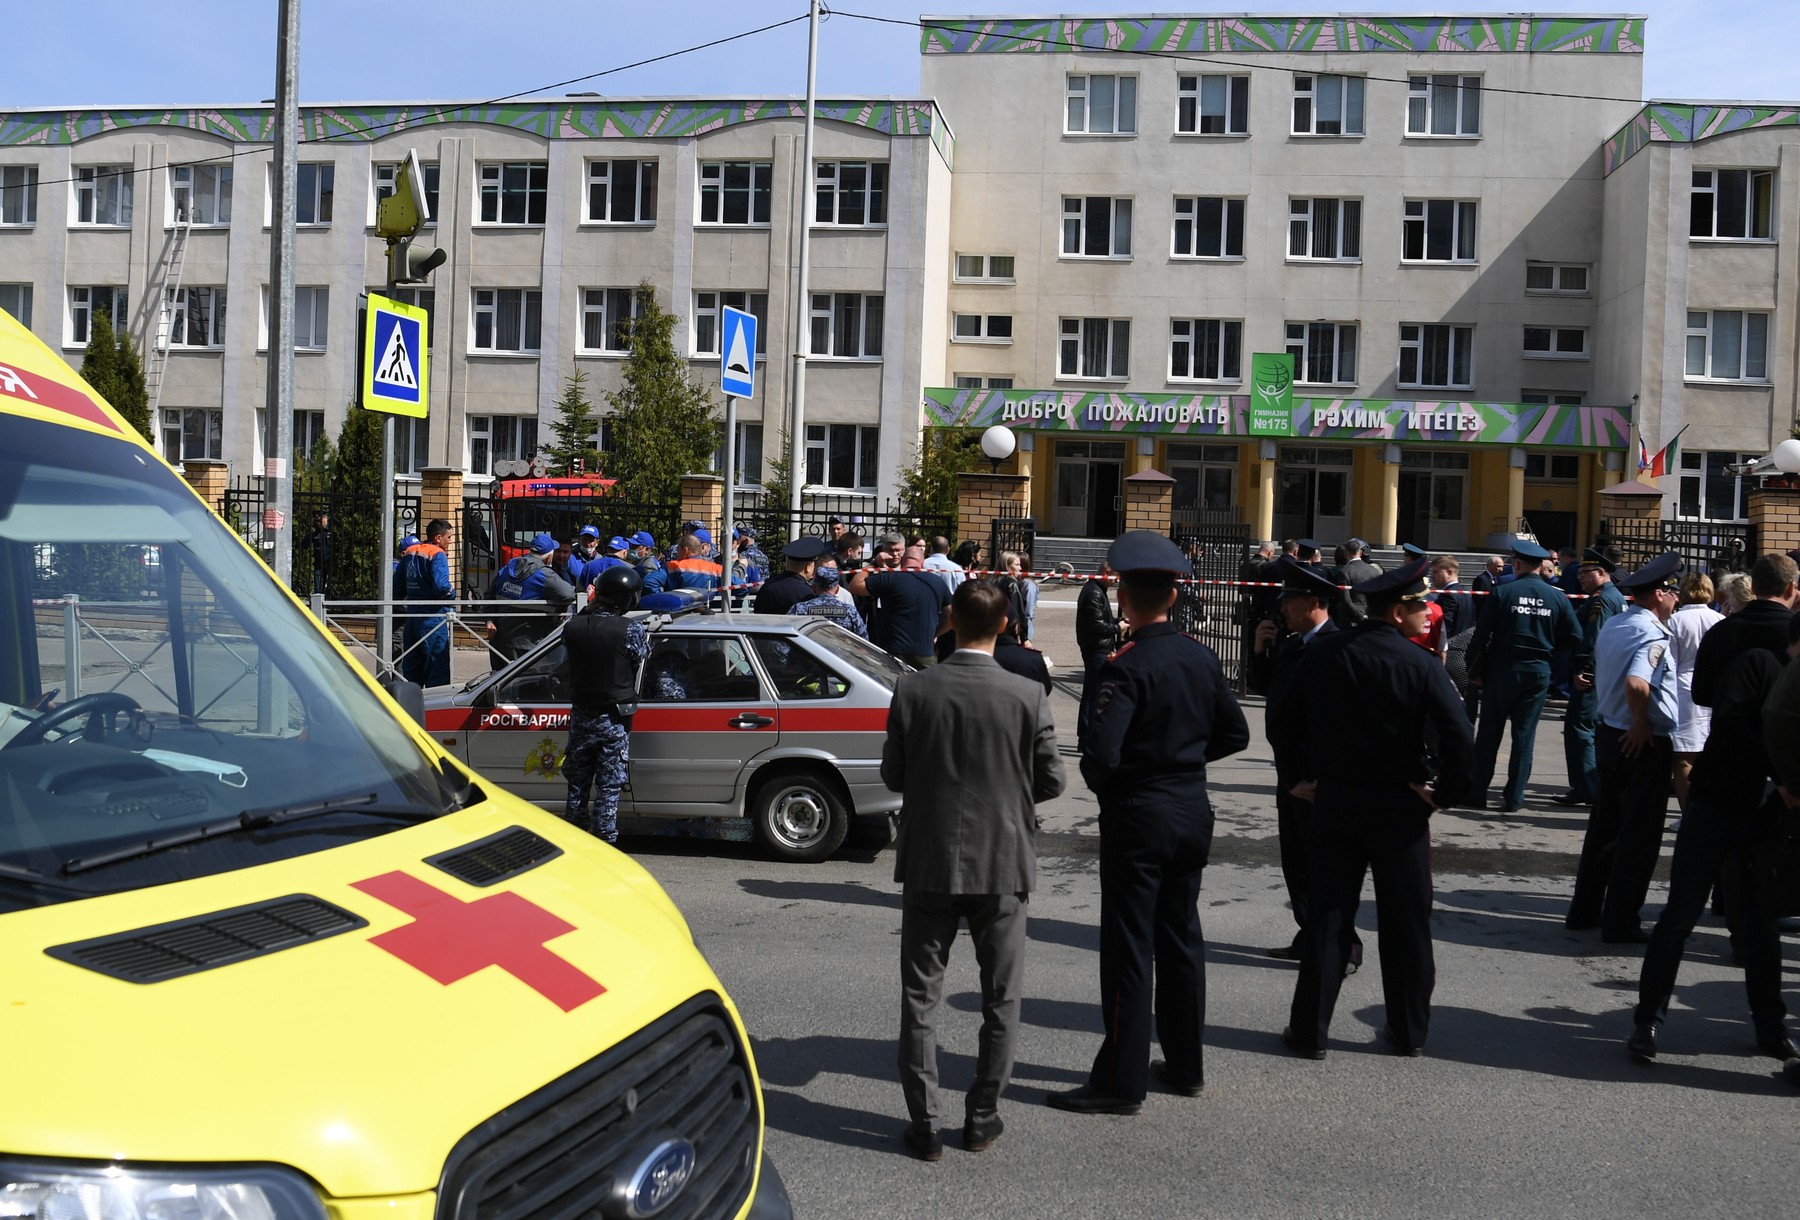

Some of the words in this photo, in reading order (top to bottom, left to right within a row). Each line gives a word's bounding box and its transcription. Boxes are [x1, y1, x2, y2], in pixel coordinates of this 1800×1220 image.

[1002, 400, 1069, 421] ДОБРО
[1088, 402, 1228, 424] ПОЖАЛОВАТЬ
[1254, 409, 1289, 417] ГИМНАЗИЯ
[1253, 418, 1288, 430] №175
[1408, 411, 1480, 431] ИТЕГЕЗ
[1519, 597, 1543, 606] МЧС
[810, 607, 844, 615] РОСГВАРДИЯ
[1511, 606, 1551, 616] РОССИИ
[651, 1153, 687, 1206] Ford
